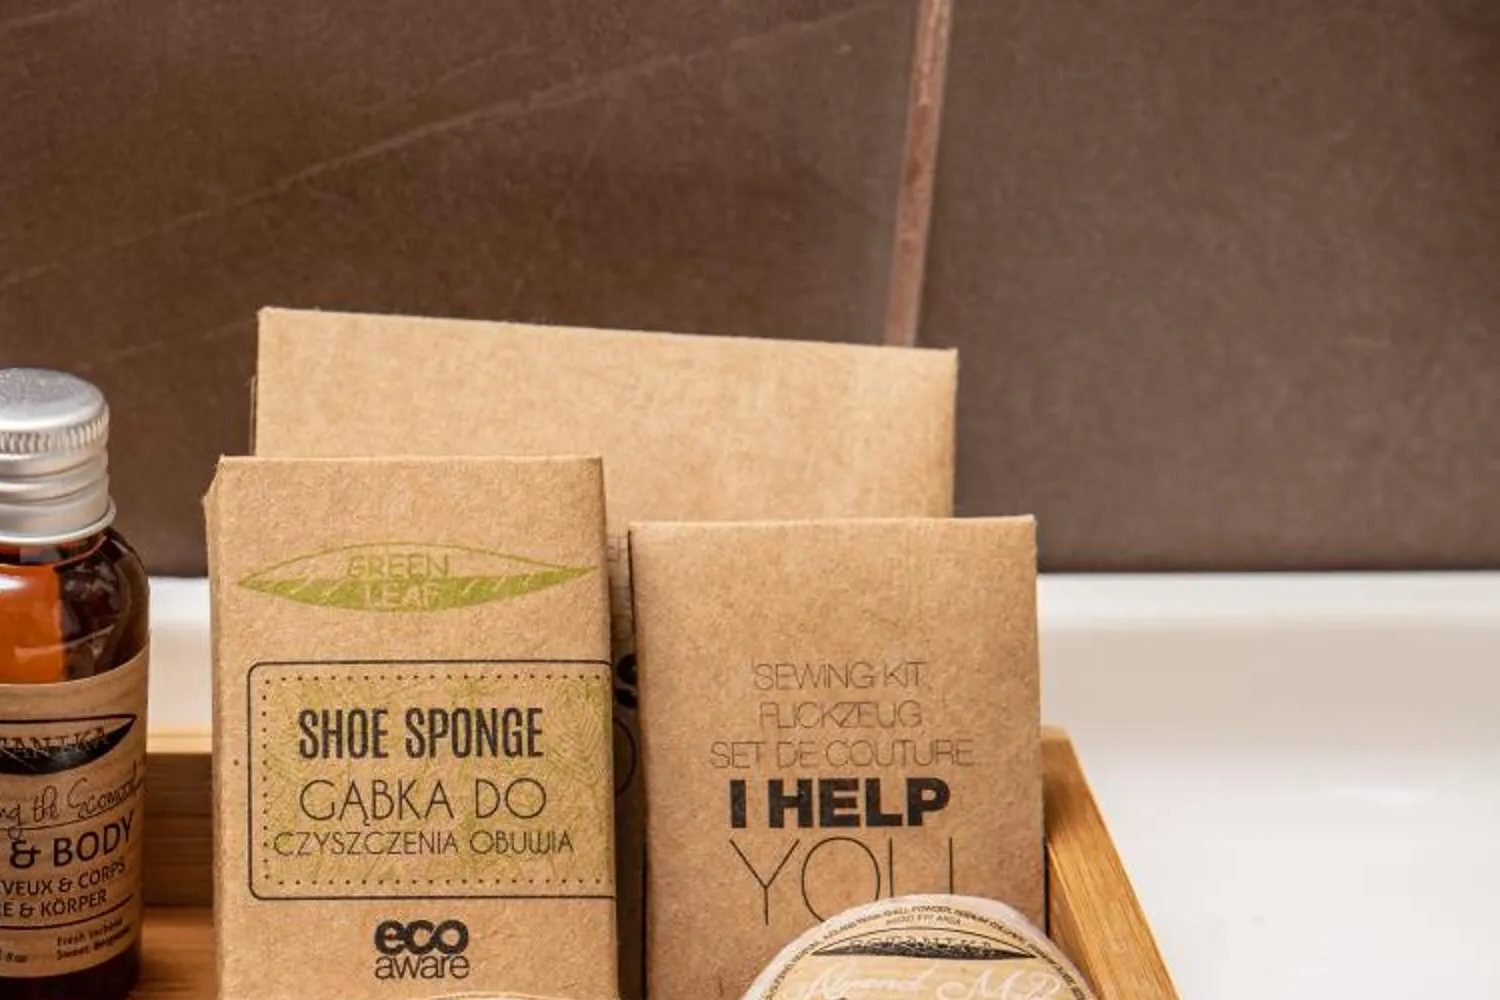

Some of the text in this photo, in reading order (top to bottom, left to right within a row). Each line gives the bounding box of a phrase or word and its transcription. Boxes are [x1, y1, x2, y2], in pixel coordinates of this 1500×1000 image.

[347, 553, 449, 577] GREEN
[361, 580, 440, 609] LEAF
[752, 660, 927, 690] SEWING KIT
[299, 706, 545, 760] SHOE SPONGE
[709, 738, 975, 769] SET DE COUTURE
[299, 776, 547, 826] GĄBKA DO
[729, 777, 951, 828] I HELP
[9, 839, 41, 869] &
[53, 810, 134, 868] BODY
[272, 829, 575, 857] CZYSZCZENIA OBUWIA
[58, 876, 73, 893] &
[78, 861, 125, 890] CORPS
[729, 836, 954, 926] YOU
[40, 889, 108, 917] KÖRPER
[374, 919, 470, 956] eco
[374, 957, 470, 980] aware
